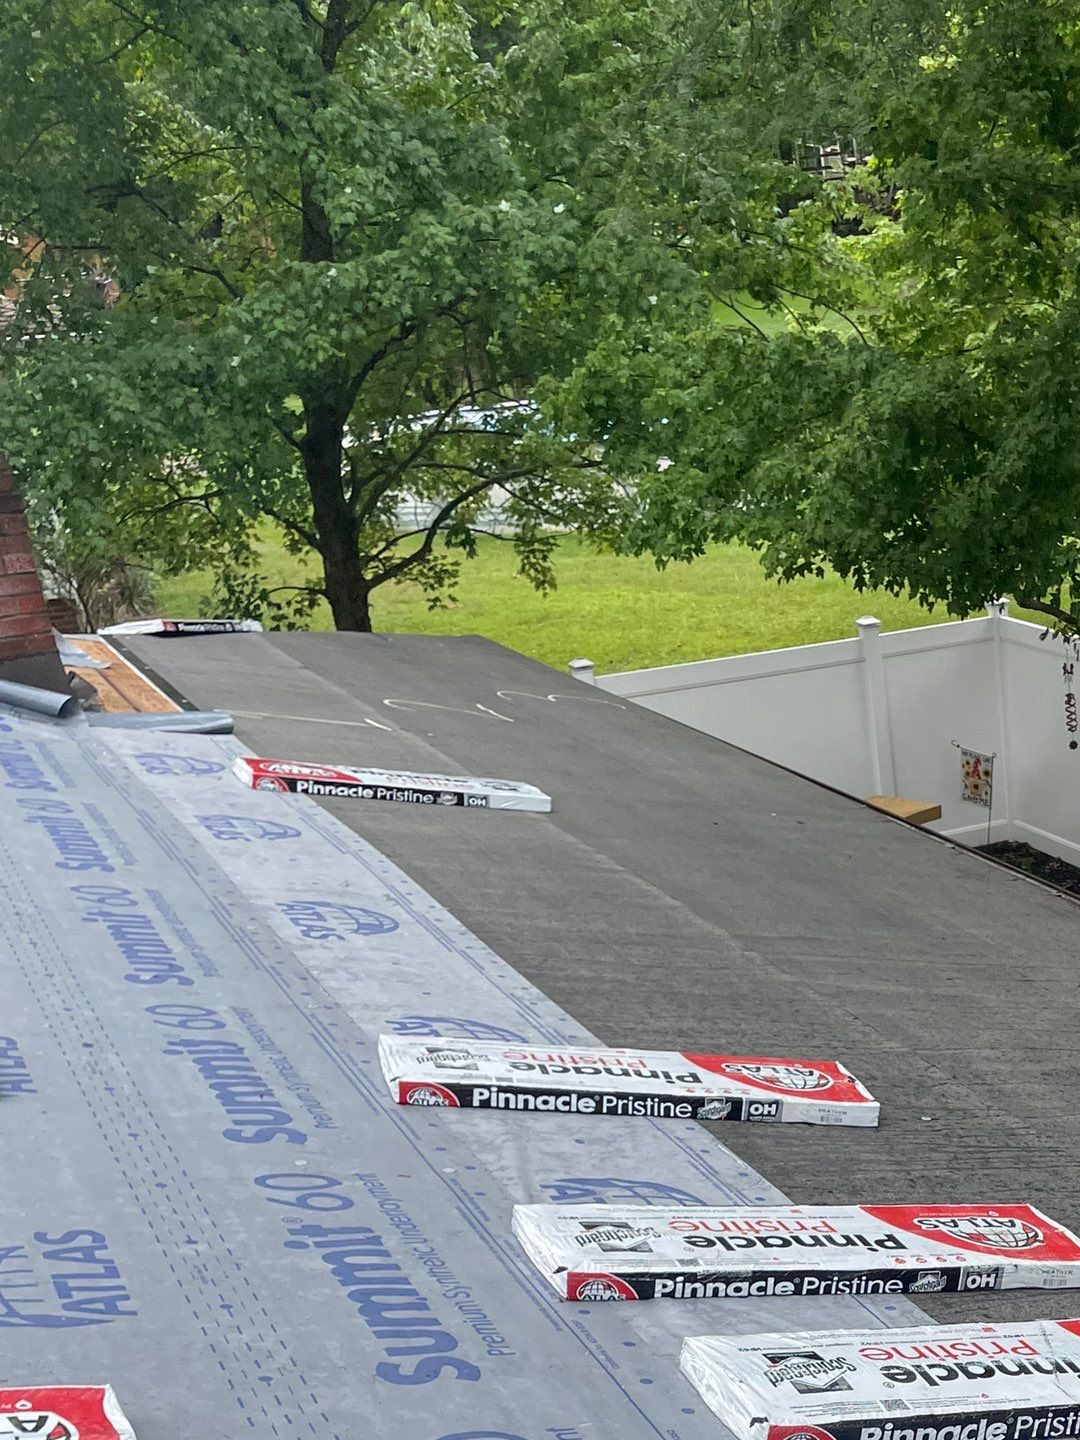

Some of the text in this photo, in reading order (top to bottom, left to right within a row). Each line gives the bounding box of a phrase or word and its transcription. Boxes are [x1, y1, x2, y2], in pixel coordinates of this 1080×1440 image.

[297, 781, 486, 807] Pinnacle Pristine OH
[82, 910, 195, 986] Summit
[503, 1051, 647, 1068] Pristine
[724, 1063, 814, 1077] ATLAS
[145, 1004, 307, 1145] Summit 60
[511, 1062, 702, 1084] Pinnacle
[472, 1087, 692, 1118] Pinnacle Pristine
[750, 1103, 777, 1116] OH
[668, 1219, 838, 1234] Pristine
[917, 1218, 1016, 1231] ATLAS
[684, 1233, 909, 1251] Pinnacle
[34, 1229, 138, 1316] ATLAS
[254, 1173, 481, 1385] Summit 60
[966, 1273, 996, 1288] OH
[653, 1275, 903, 1298] Pinnacle Pristine
[858, 1339, 1040, 1361] Pristine
[765, 1355, 858, 1387] Scotchgard
